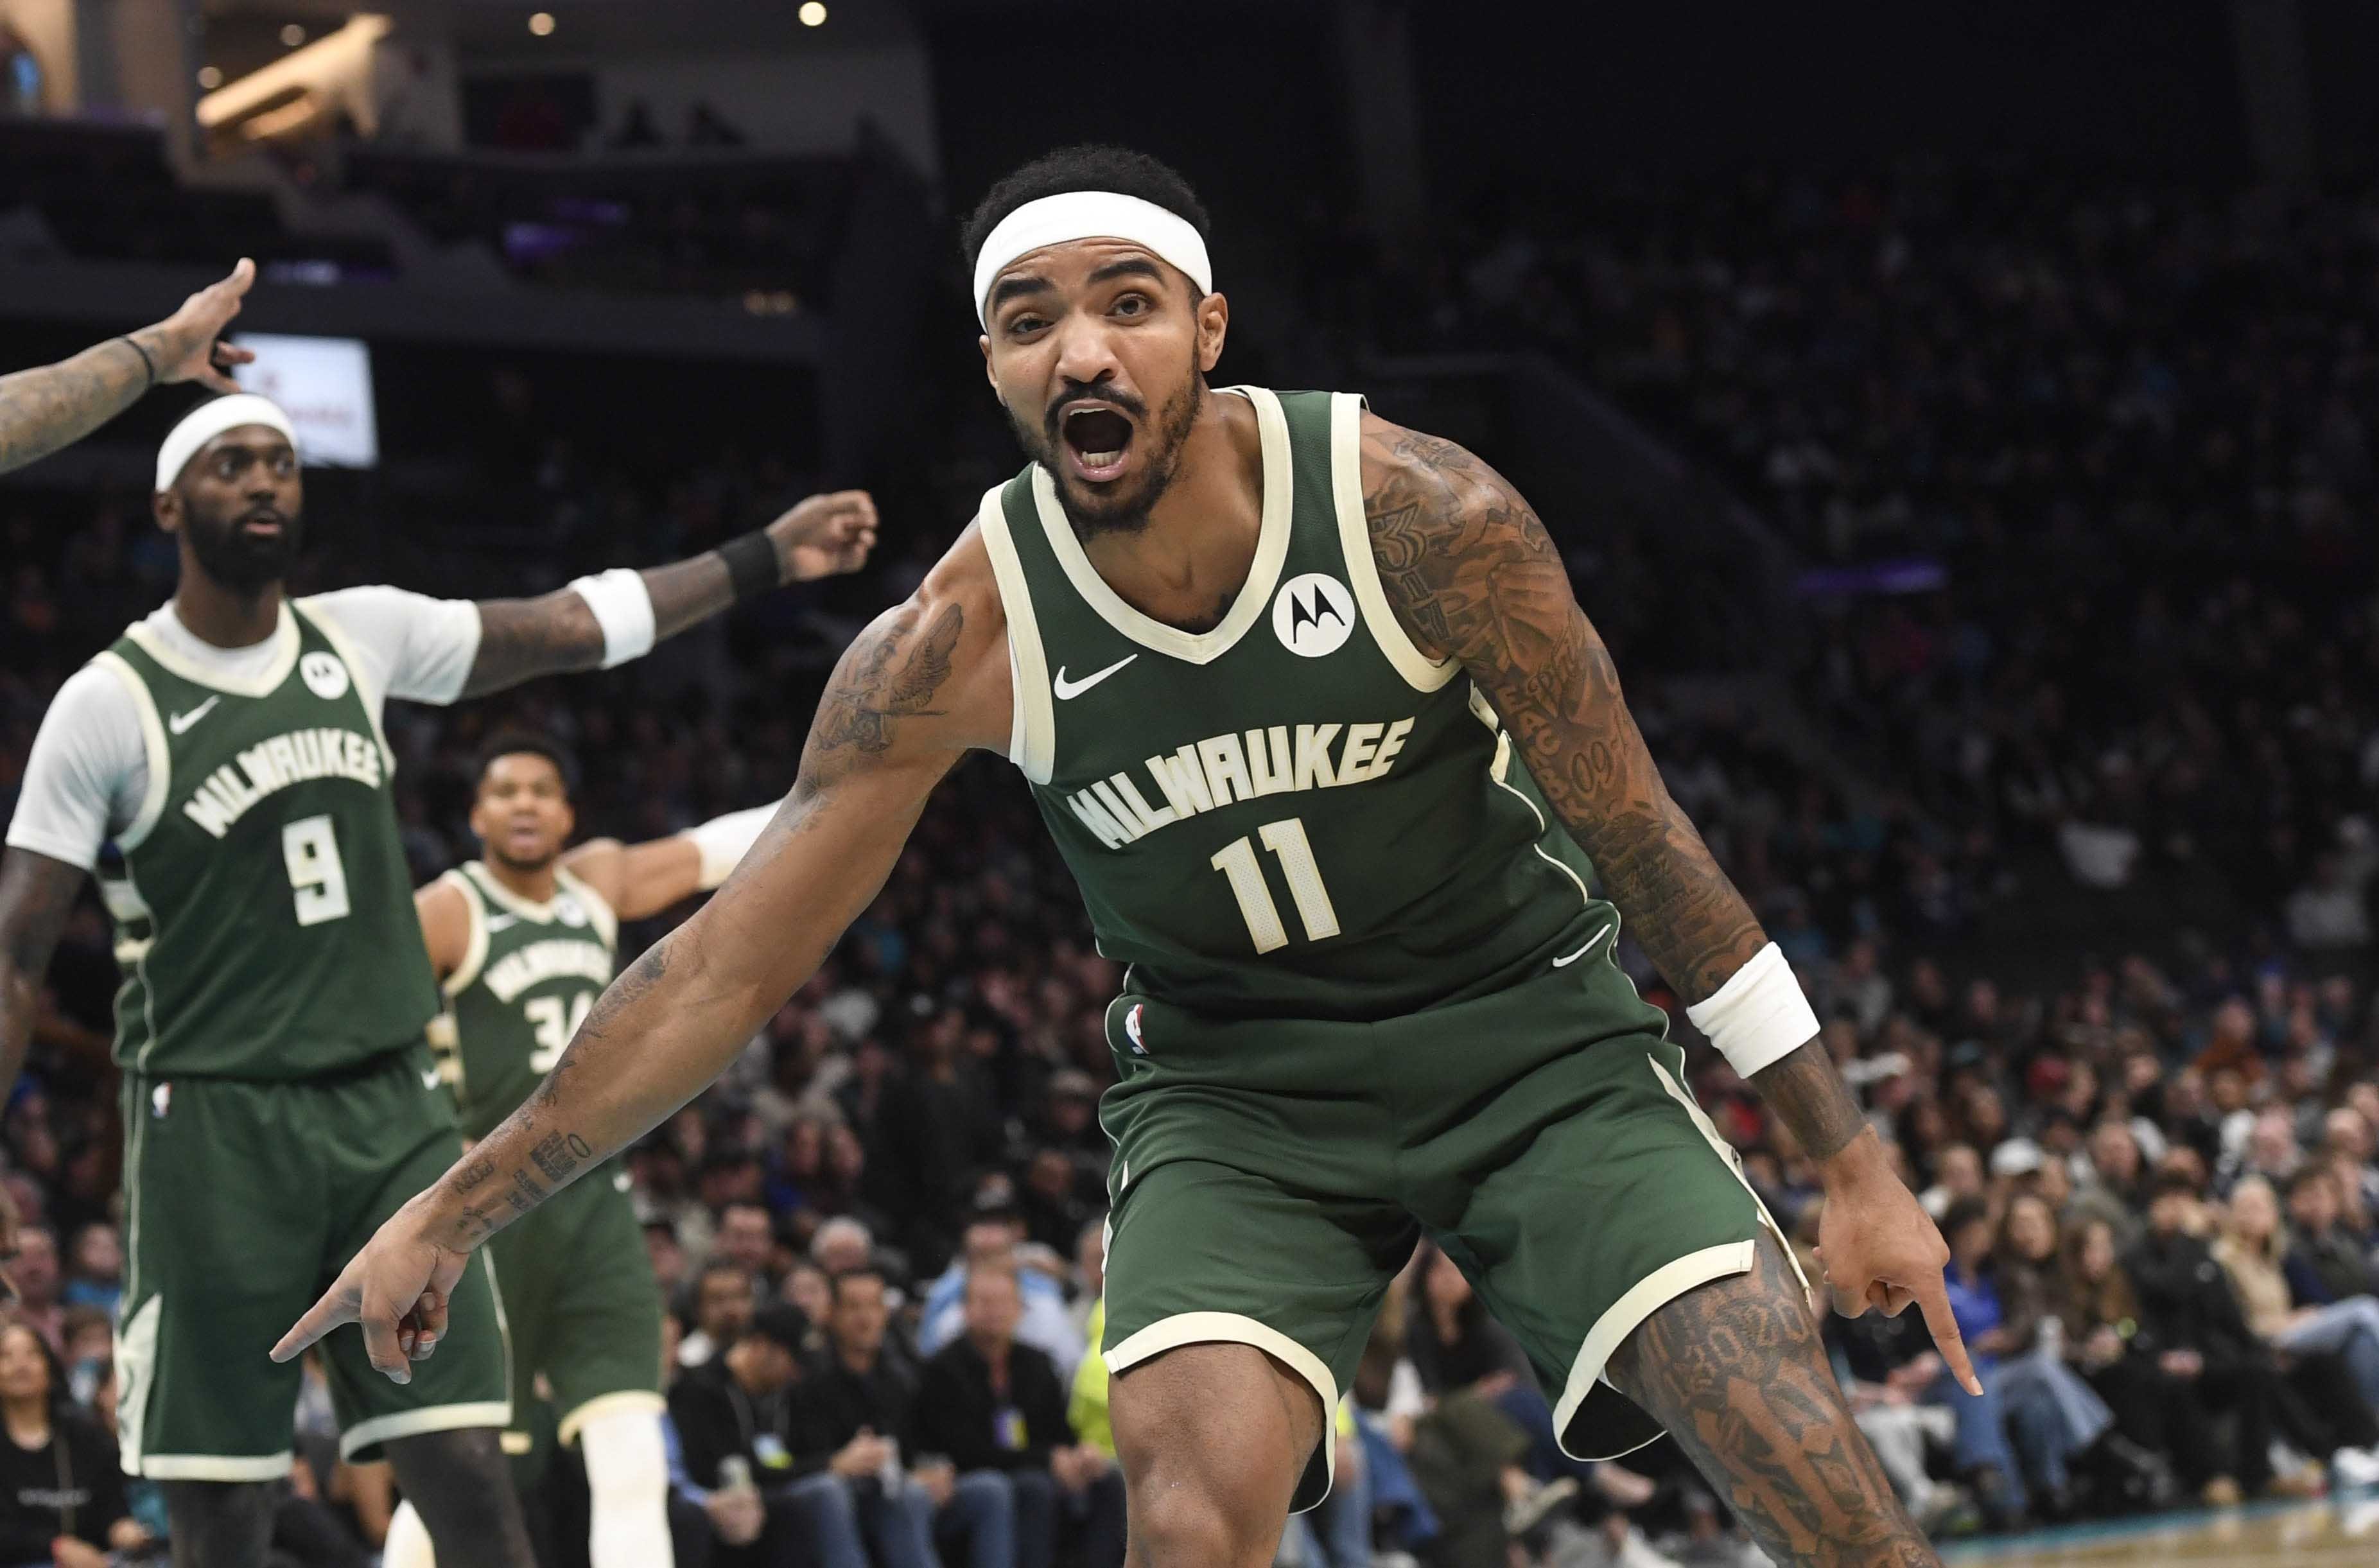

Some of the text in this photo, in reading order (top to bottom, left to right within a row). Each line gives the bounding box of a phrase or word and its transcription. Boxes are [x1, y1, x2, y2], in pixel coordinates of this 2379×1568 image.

[183, 727, 381, 839] MILWAUKEE
[1067, 716, 1415, 849] MILWAUKEE
[281, 814, 351, 927] 9
[1210, 817, 1341, 954] 11
